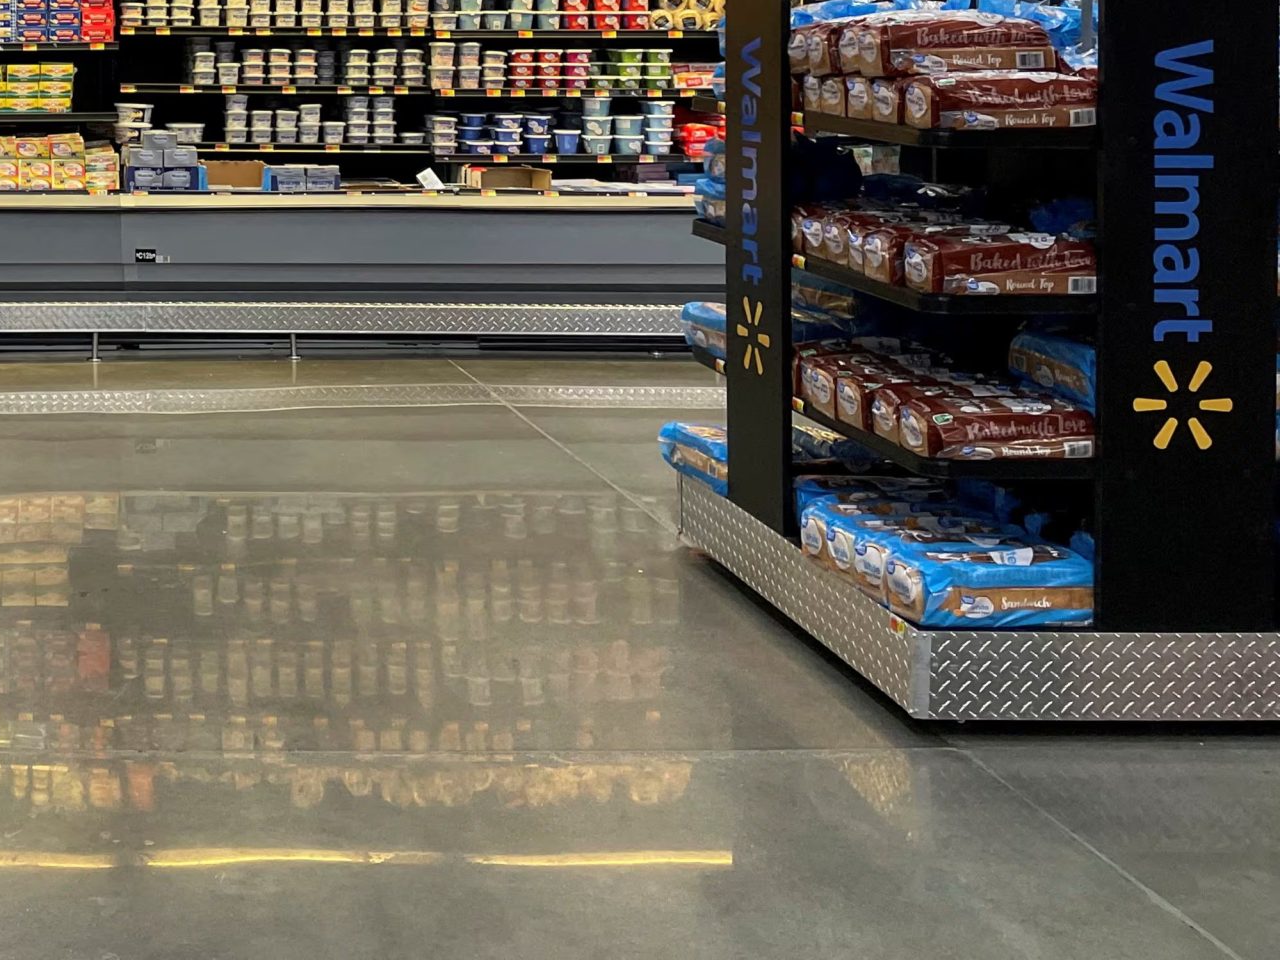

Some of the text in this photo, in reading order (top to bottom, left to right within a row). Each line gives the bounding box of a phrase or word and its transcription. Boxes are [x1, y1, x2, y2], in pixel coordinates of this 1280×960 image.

[952, 54, 1003, 67] Round Top
[1004, 113, 1057, 127] Round Top
[741, 36, 763, 287] Walmart
[1153, 39, 1215, 343] Walmart
[970, 251, 1021, 272] Baked
[1005, 278, 1055, 292] Round Top
[1000, 596, 1052, 609] Sandwich
